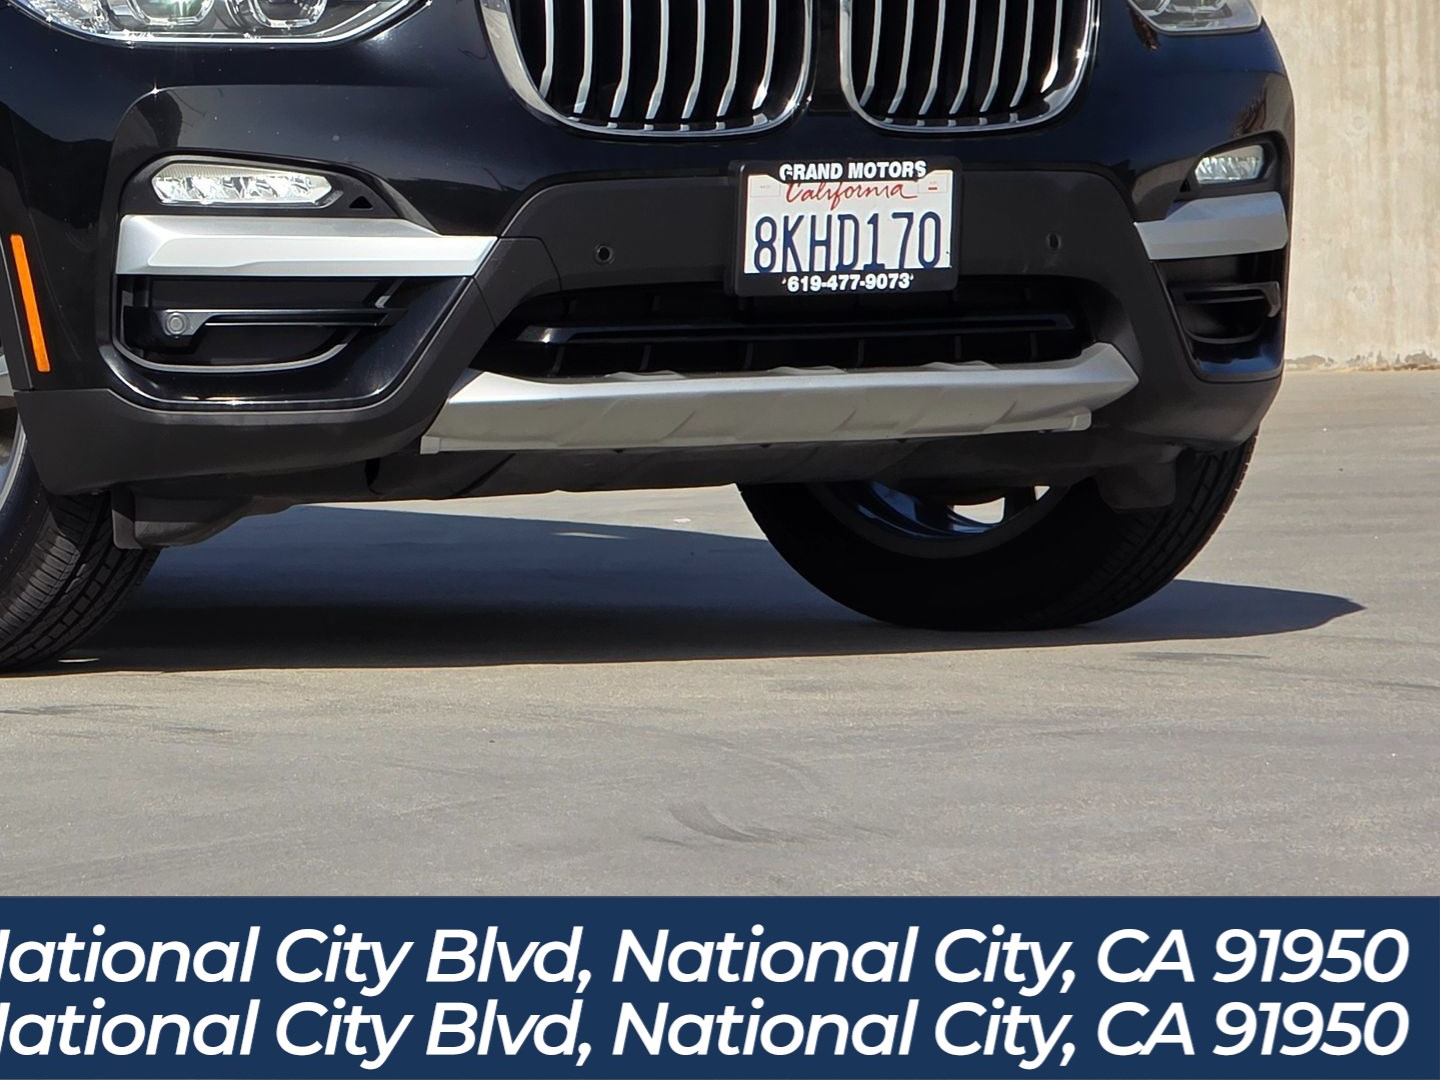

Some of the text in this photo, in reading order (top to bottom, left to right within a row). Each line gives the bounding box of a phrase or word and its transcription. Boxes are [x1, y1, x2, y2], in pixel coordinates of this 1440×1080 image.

[779, 161, 927, 181] GRAND MOTORS
[785, 181, 918, 211] California
[753, 211, 942, 273] 8KHD170
[786, 273, 911, 293] 619-477-9073
